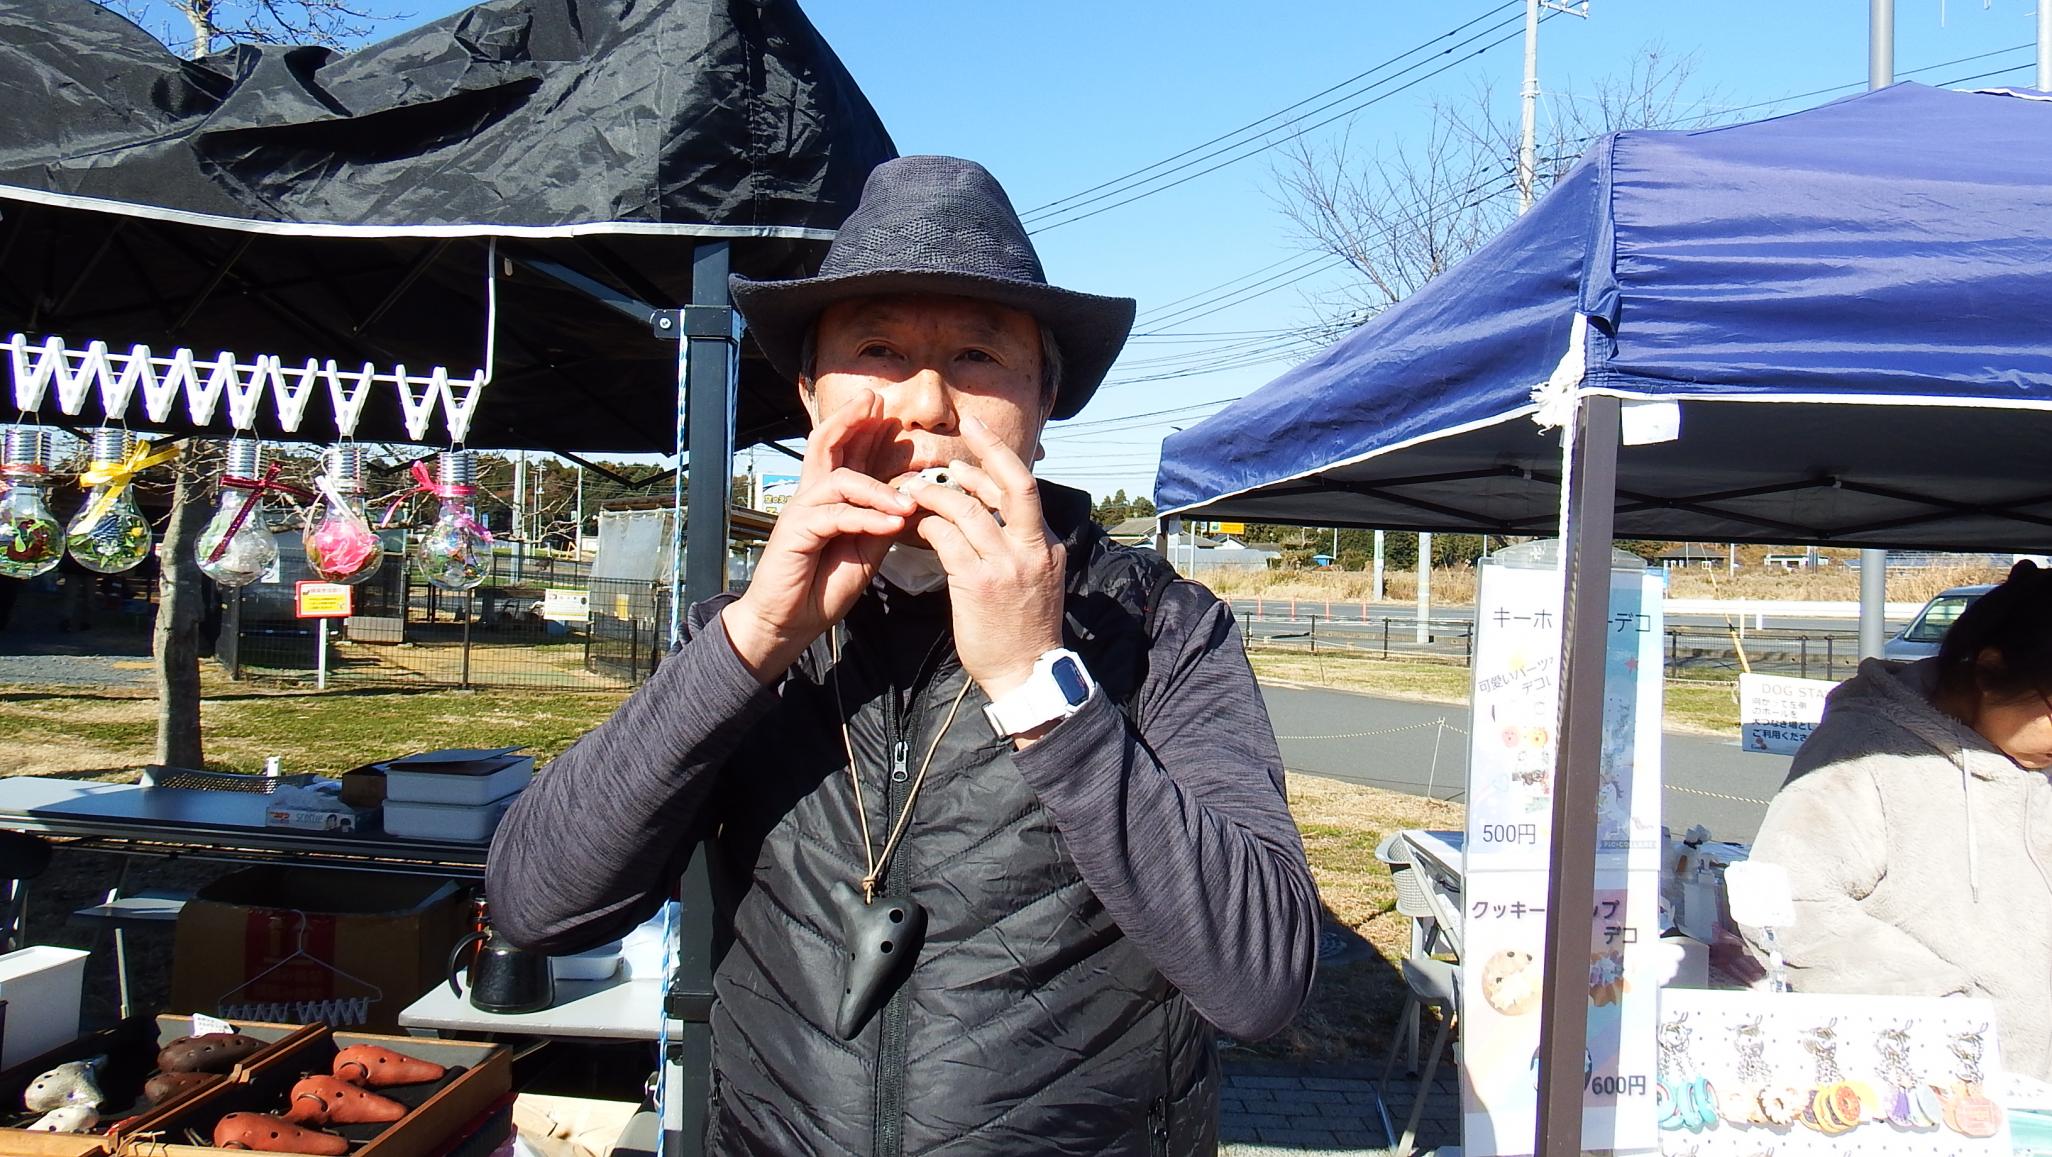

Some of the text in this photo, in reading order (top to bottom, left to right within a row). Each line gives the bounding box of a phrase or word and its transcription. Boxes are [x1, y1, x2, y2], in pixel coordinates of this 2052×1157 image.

[1762, 683, 1828, 699] DOG STA
[1483, 823, 1536, 845] 500円
[1591, 1075, 1647, 1096] 600円
